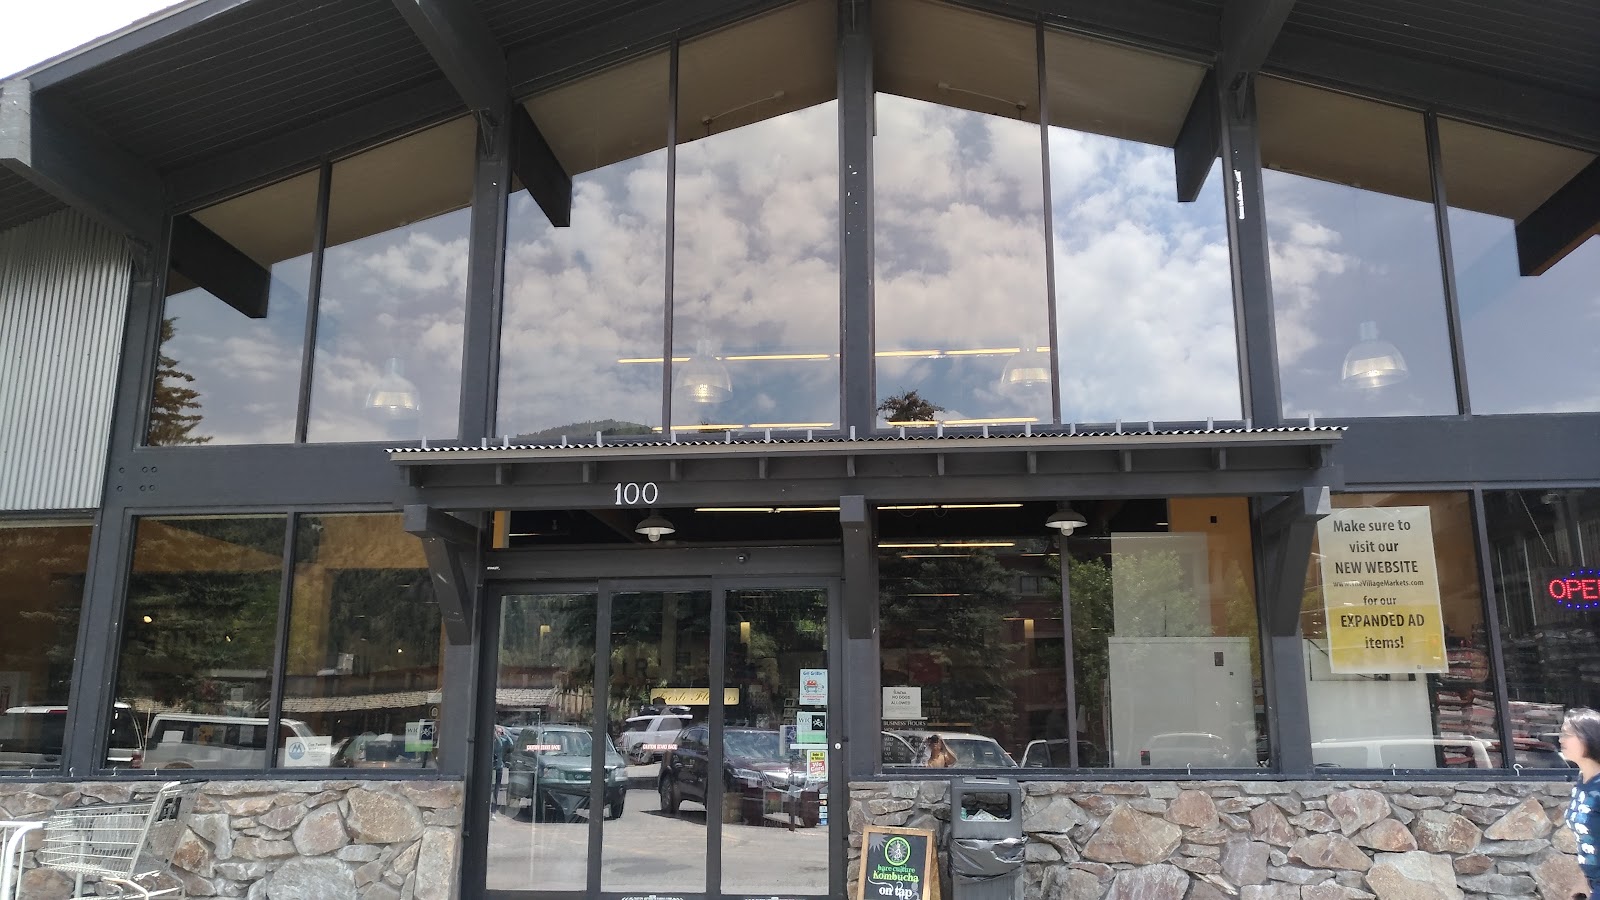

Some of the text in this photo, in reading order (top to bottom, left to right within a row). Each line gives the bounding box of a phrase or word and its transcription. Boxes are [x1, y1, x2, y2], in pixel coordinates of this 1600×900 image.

[614, 482, 658, 505] 100
[1333, 519, 1411, 532] Make sure to
[1349, 540, 1399, 553] visit our
[1335, 560, 1419, 574] NEW WEBSITE
[1549, 579, 1600, 599] OPE
[1363, 595, 1397, 606] for our
[1340, 614, 1425, 628] EXPANDED AD
[1365, 635, 1404, 649] items!
[877, 864, 915, 873] bare culture
[873, 870, 920, 883] Kombucha
[878, 883, 912, 899] on tap
